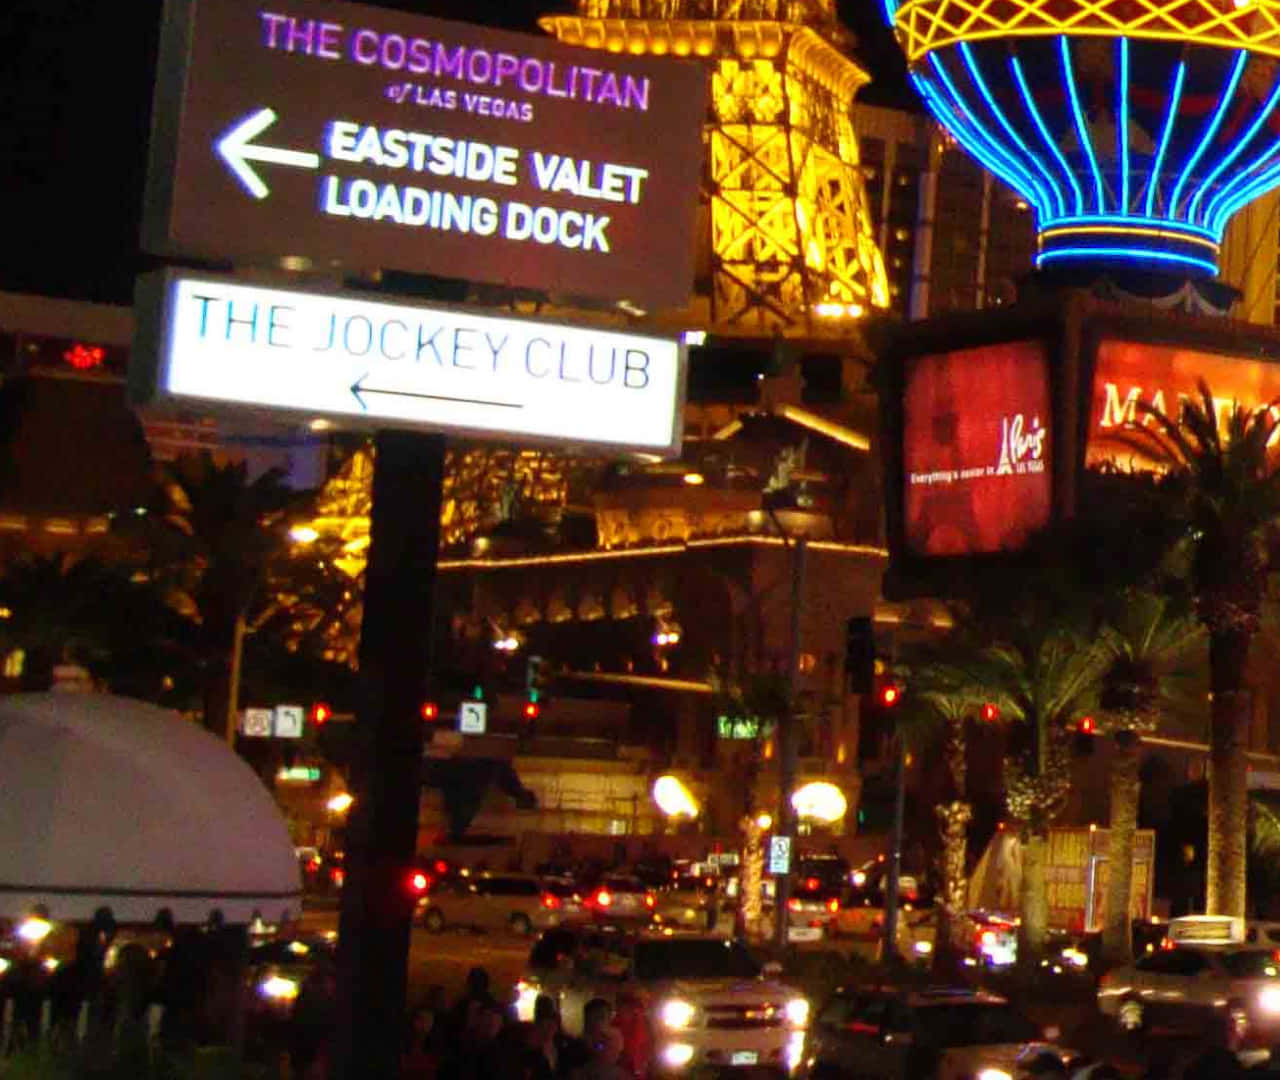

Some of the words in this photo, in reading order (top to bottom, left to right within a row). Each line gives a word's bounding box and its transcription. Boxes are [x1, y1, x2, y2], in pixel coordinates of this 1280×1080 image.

[261, 11, 341, 62] THE
[351, 28, 650, 111] COSMOPOLITAN
[416, 86, 458, 111] LAS
[463, 92, 534, 122] VEGAS
[330, 121, 519, 184] EASTSIDE
[533, 151, 649, 205] VALET
[324, 176, 498, 236] LOADING
[505, 204, 611, 253] DOCK
[191, 294, 294, 349] THE
[312, 310, 511, 375] JOCKEY
[523, 336, 652, 391] CLUB
